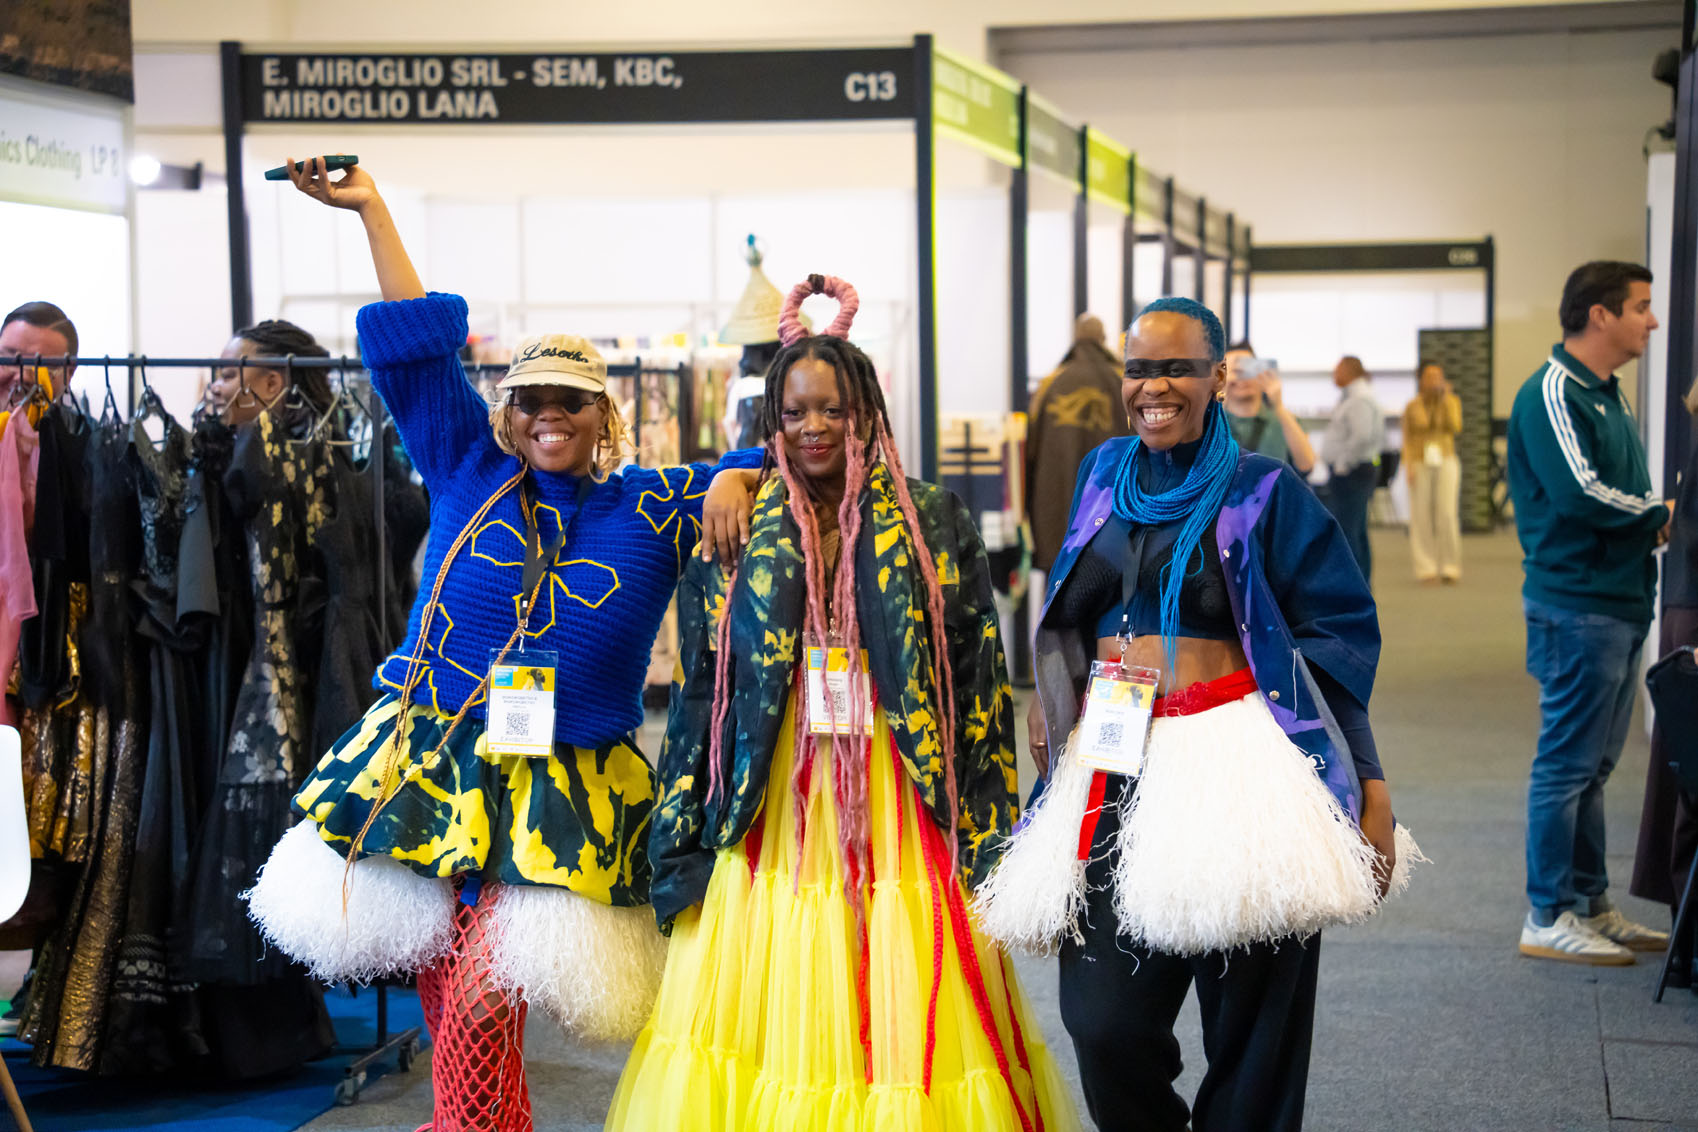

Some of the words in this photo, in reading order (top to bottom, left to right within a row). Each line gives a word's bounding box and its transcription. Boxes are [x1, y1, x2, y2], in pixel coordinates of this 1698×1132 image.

[262, 58, 289, 86] E.
[297, 58, 444, 87] MIROGLIO
[451, 57, 508, 87] SRL
[532, 57, 607, 90] SEM,
[614, 57, 683, 90] KBC,
[844, 71, 898, 102] C13
[263, 89, 410, 118] MIROGLIO
[417, 89, 499, 118] LANA
[26, 134, 81, 180] Clothing
